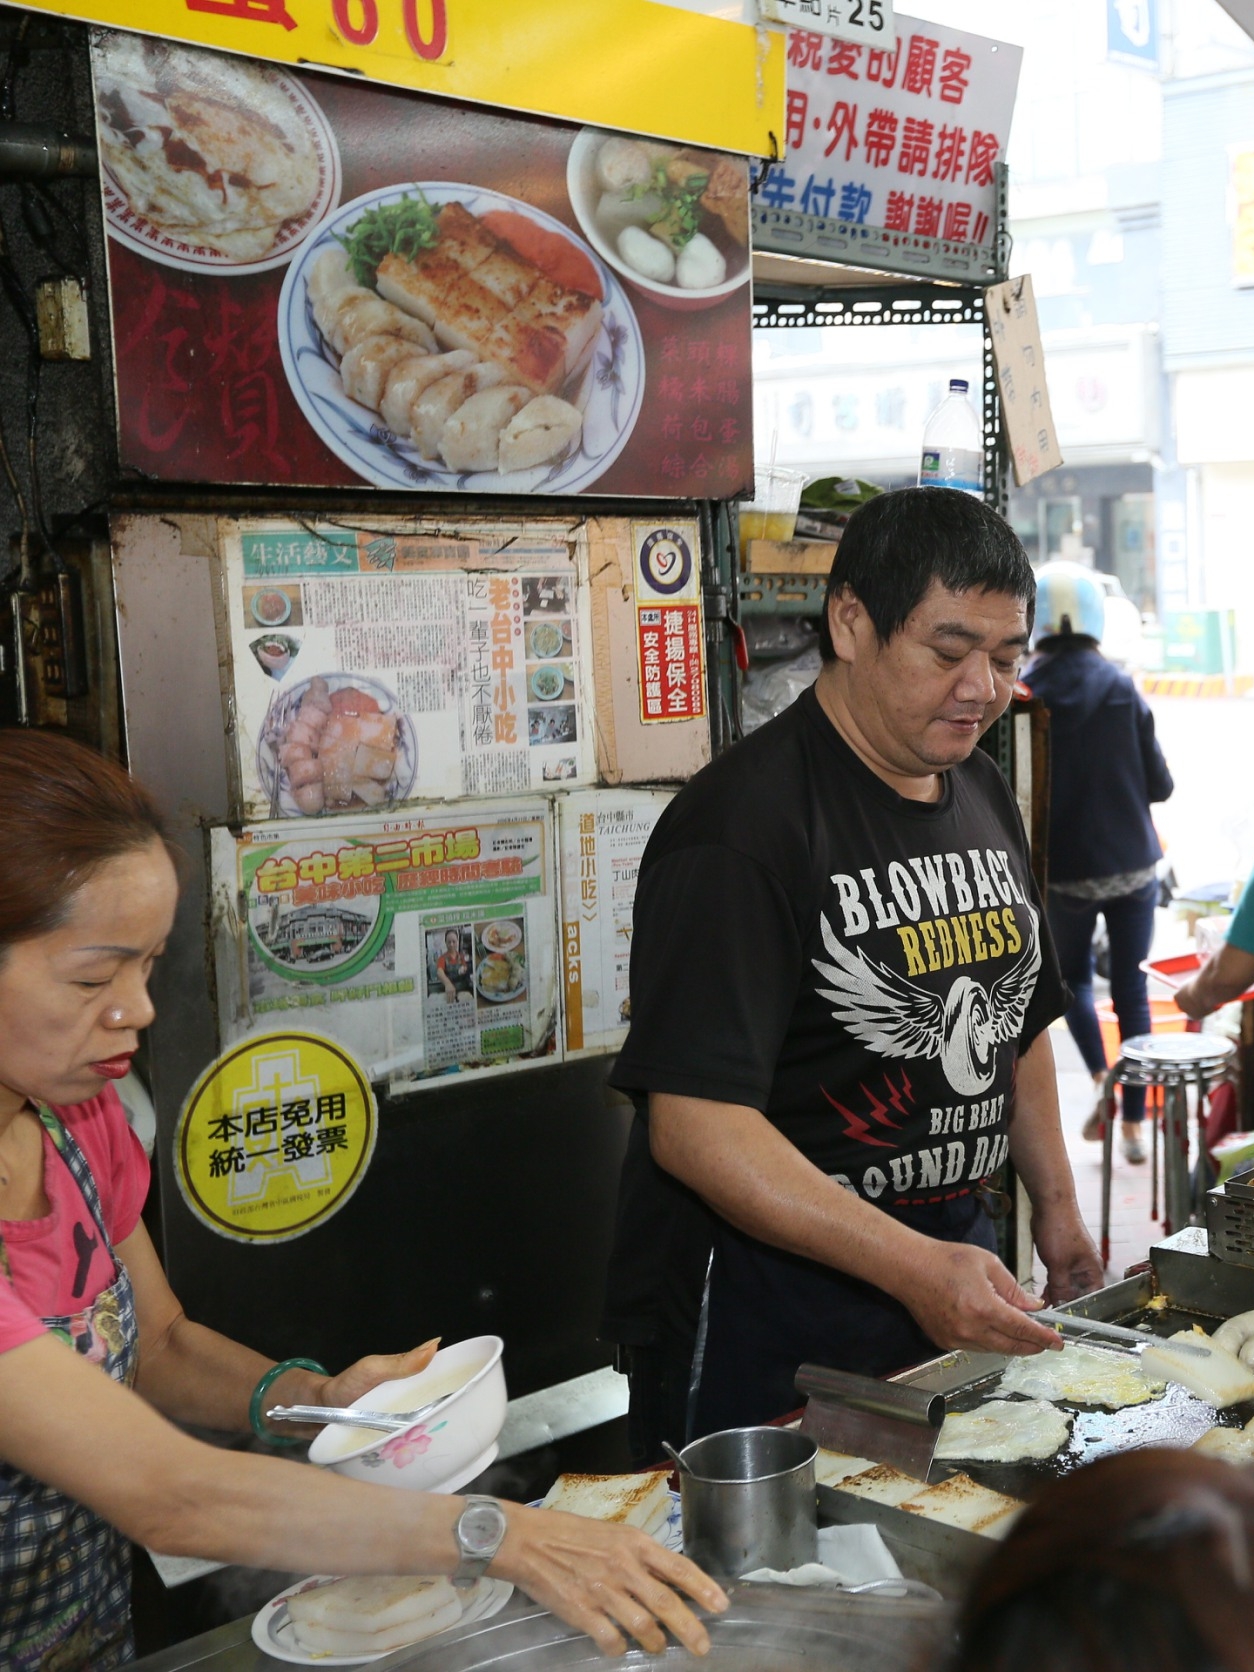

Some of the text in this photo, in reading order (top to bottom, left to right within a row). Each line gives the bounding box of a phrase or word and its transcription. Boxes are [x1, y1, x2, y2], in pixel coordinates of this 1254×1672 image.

[849, 0, 884, 31] 25
[661, 414, 740, 444] 荷包蛋
[662, 453, 740, 480] 綜合湯
[251, 540, 353, 566] 生活藝文
[467, 578, 493, 747] 吃一輩子也不厭倦
[489, 578, 517, 745] 老台中小吃
[644, 631, 662, 715] 安全防護區
[664, 610, 688, 712] 捷揚保全
[256, 827, 481, 893] 台中第二市場
[896, 907, 1022, 977] REDNESS
[208, 1093, 346, 1142] 本店免用
[929, 1095, 1005, 1135] BIG BEAT
[209, 1125, 349, 1178] 統一發票
